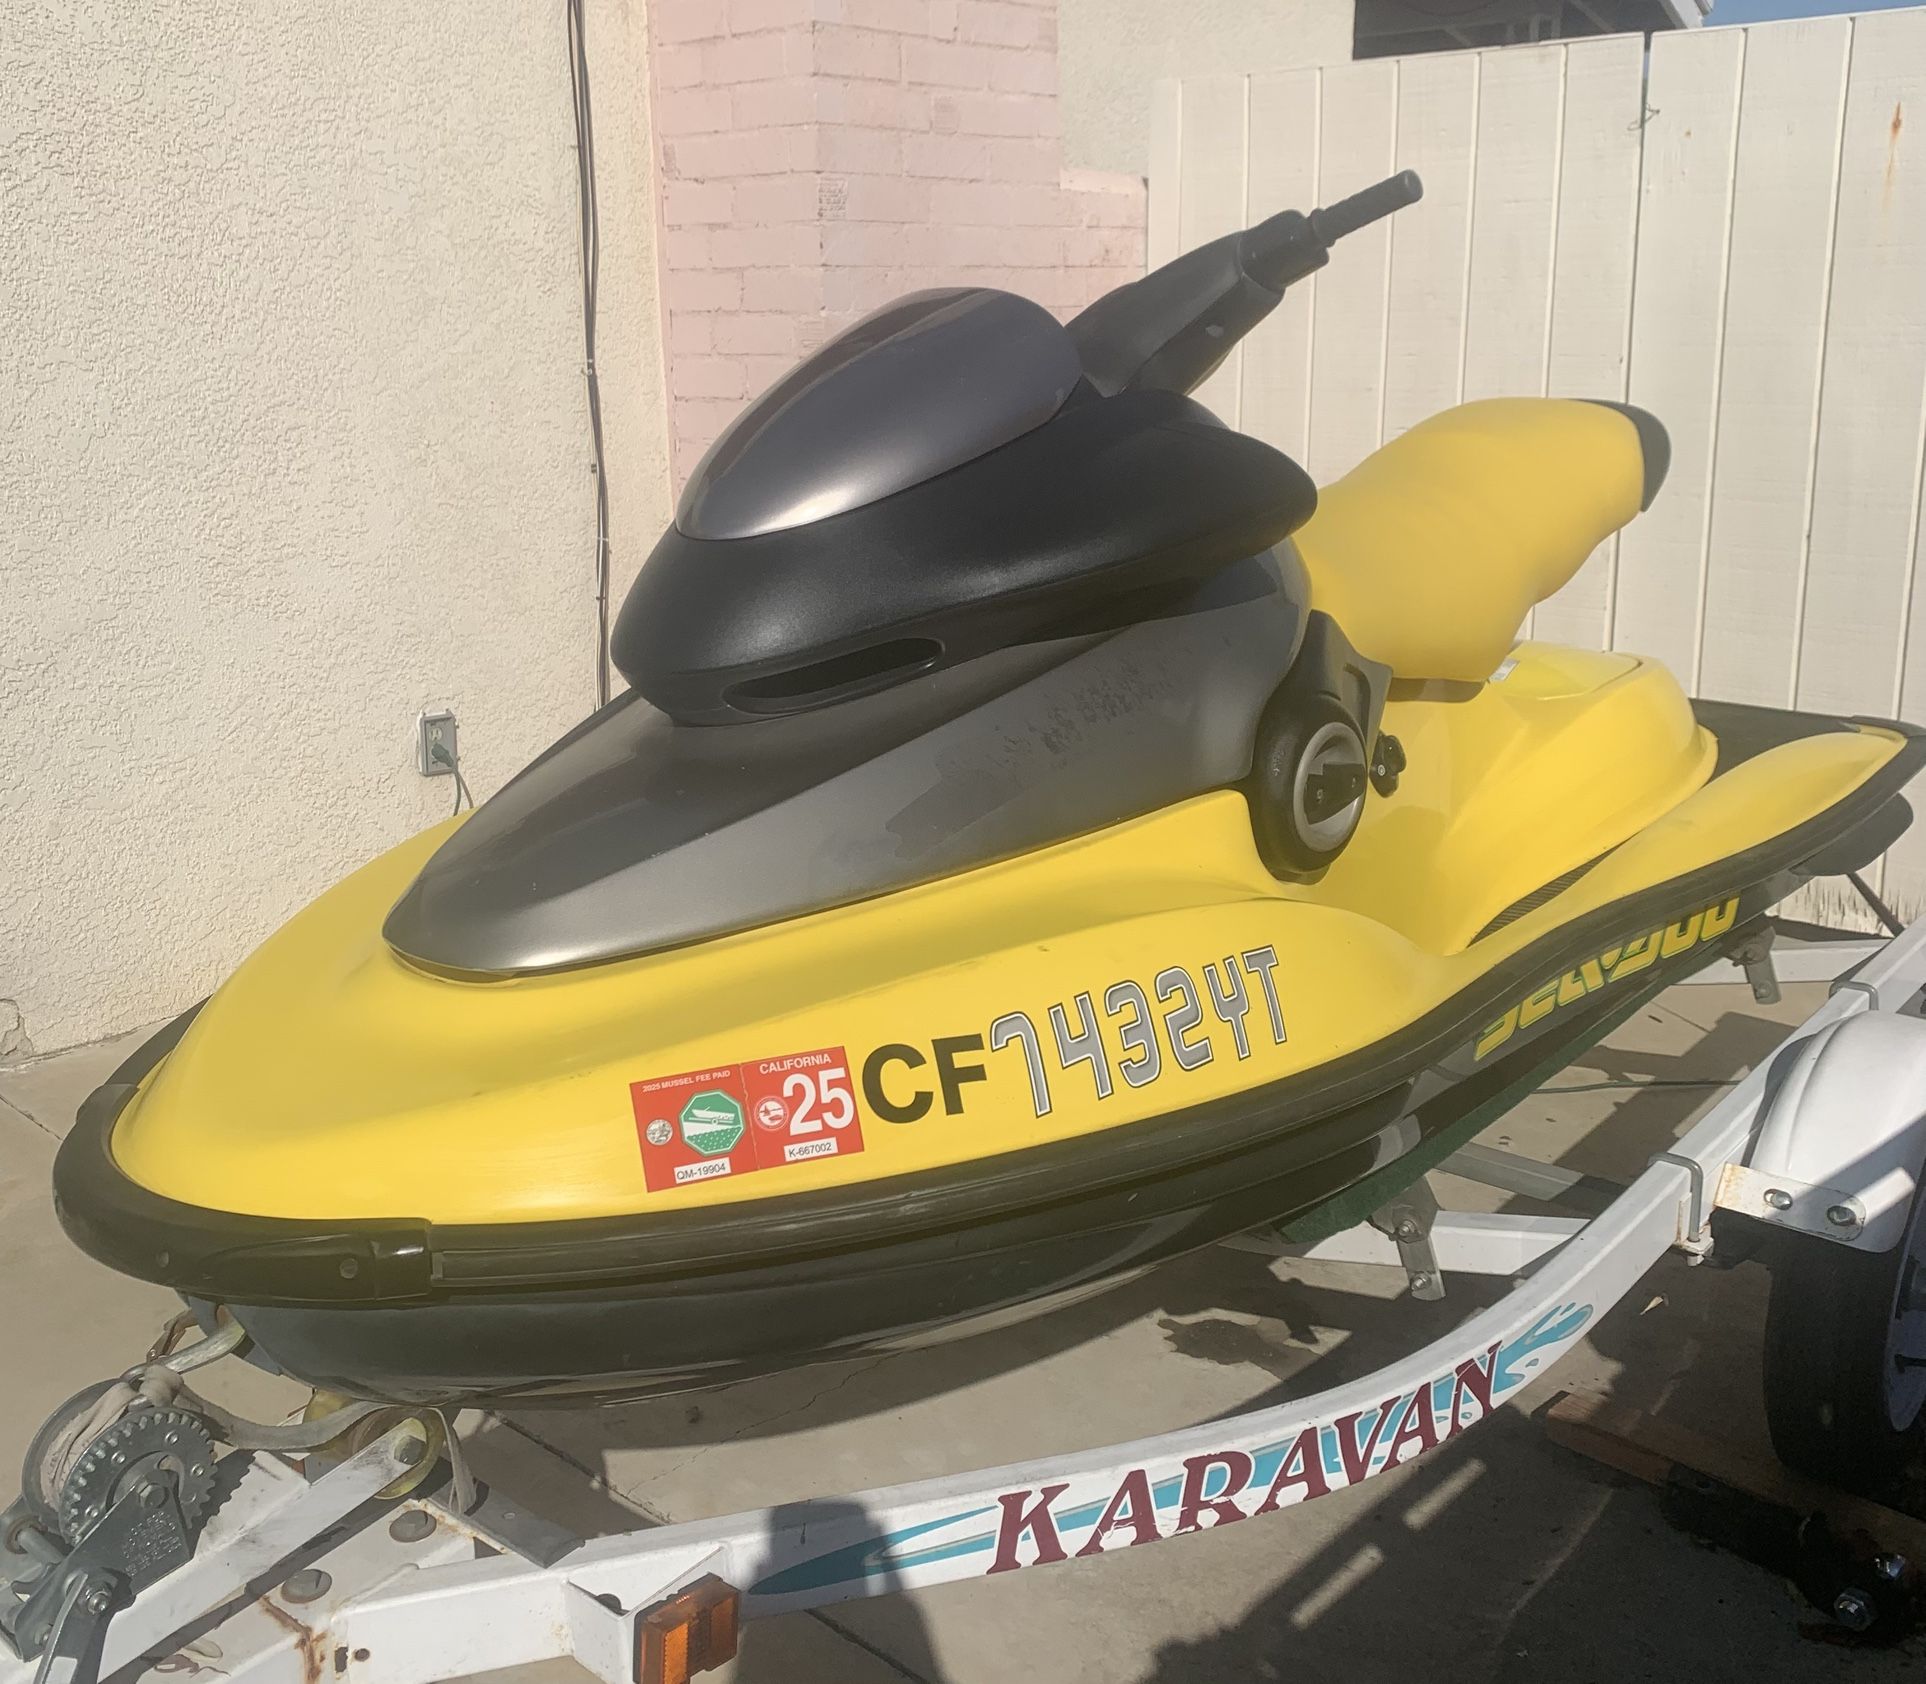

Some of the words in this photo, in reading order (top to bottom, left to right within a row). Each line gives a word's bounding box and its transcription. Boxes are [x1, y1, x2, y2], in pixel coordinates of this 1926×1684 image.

[759, 1053, 832, 1075] CALIFORNIA
[642, 1082, 660, 1092] 2025
[661, 1076, 695, 1089] MUSSEL
[695, 1073, 711, 1083] FEE
[712, 1070, 731, 1079] PAID
[783, 1067, 855, 1136] 25
[788, 1142, 832, 1158] K-667002
[676, 1163, 726, 1180] QM-19904
[986, 1340, 1502, 1575] KARAVAN
